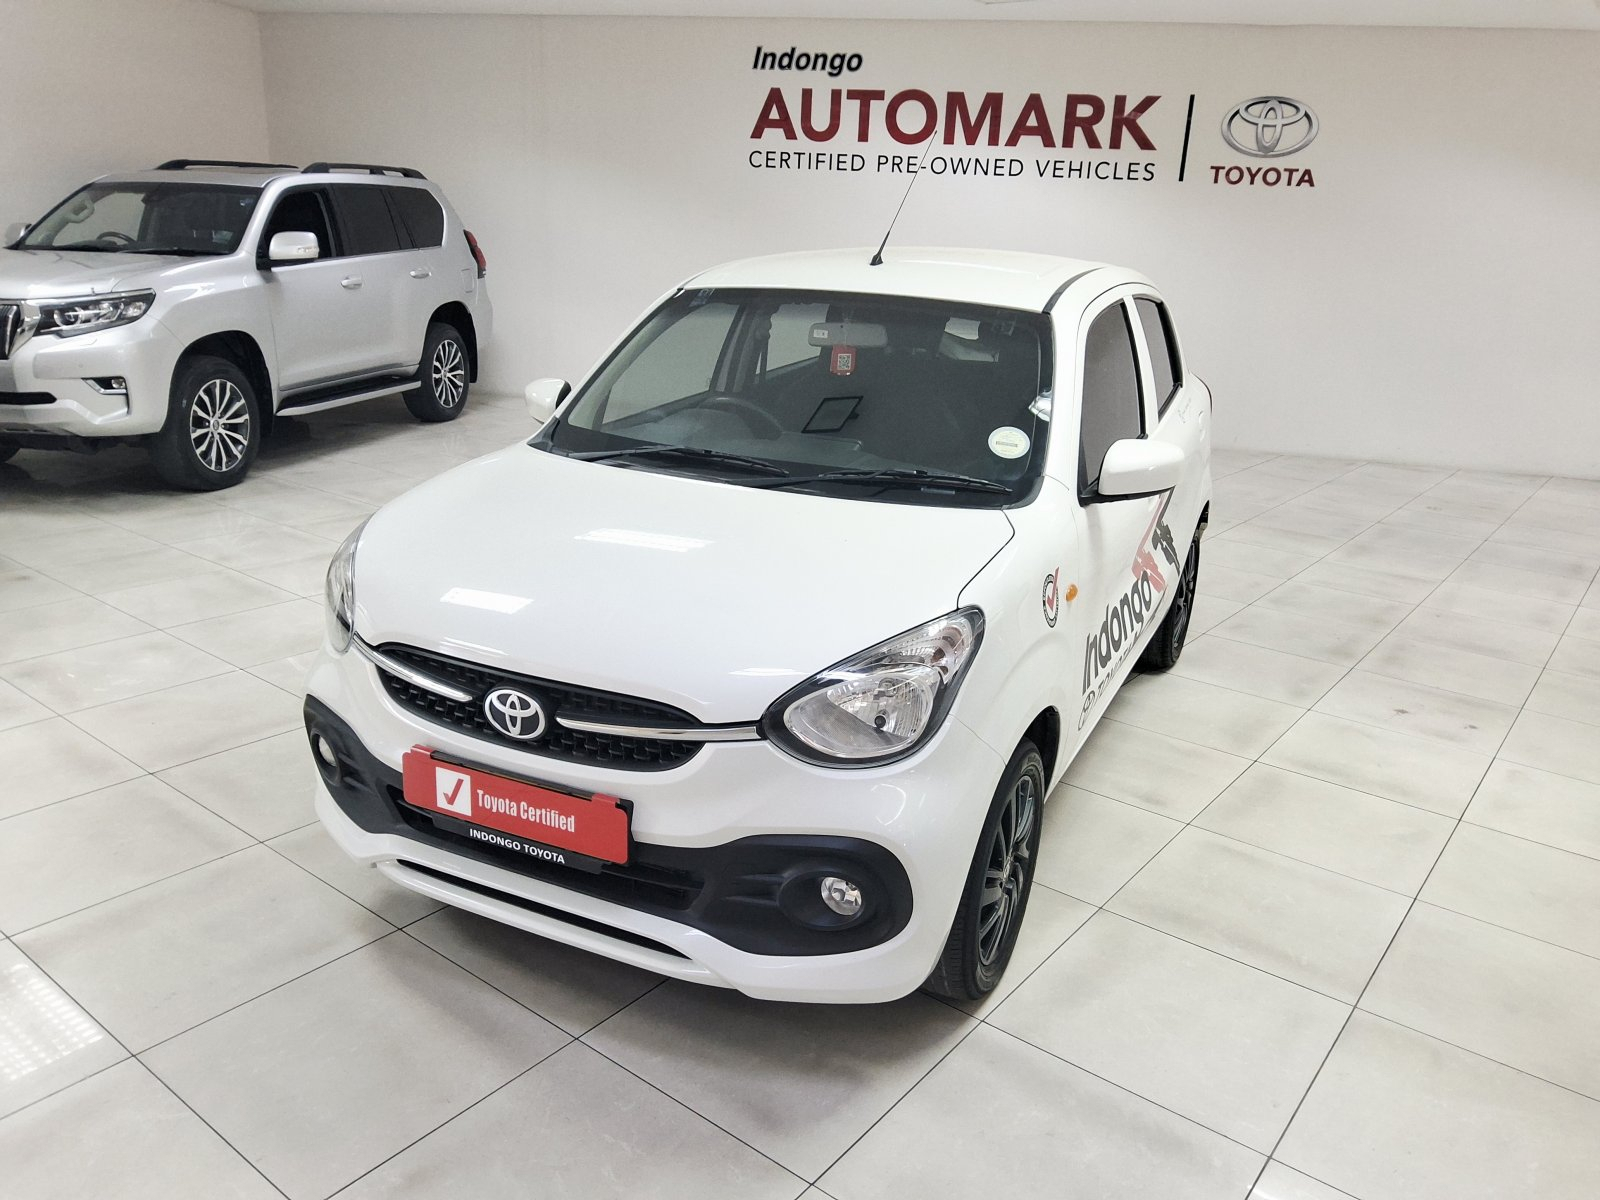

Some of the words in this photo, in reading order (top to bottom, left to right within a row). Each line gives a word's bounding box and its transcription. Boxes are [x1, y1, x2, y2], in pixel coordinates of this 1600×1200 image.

[752, 46, 864, 78] Indongo
[750, 87, 1163, 151] AUTOMARK
[748, 150, 866, 172] CERTIFIED
[877, 154, 1024, 178] PRE-OWNED
[1035, 158, 1156, 182] VEHICLES
[1209, 165, 1316, 188] TOYOTA
[1082, 570, 1152, 696] Indongo
[476, 789, 518, 817] Toyota
[519, 801, 575, 833] Certified
[469, 828, 521, 851] INDONGO
[523, 843, 566, 865] TOYOTA
